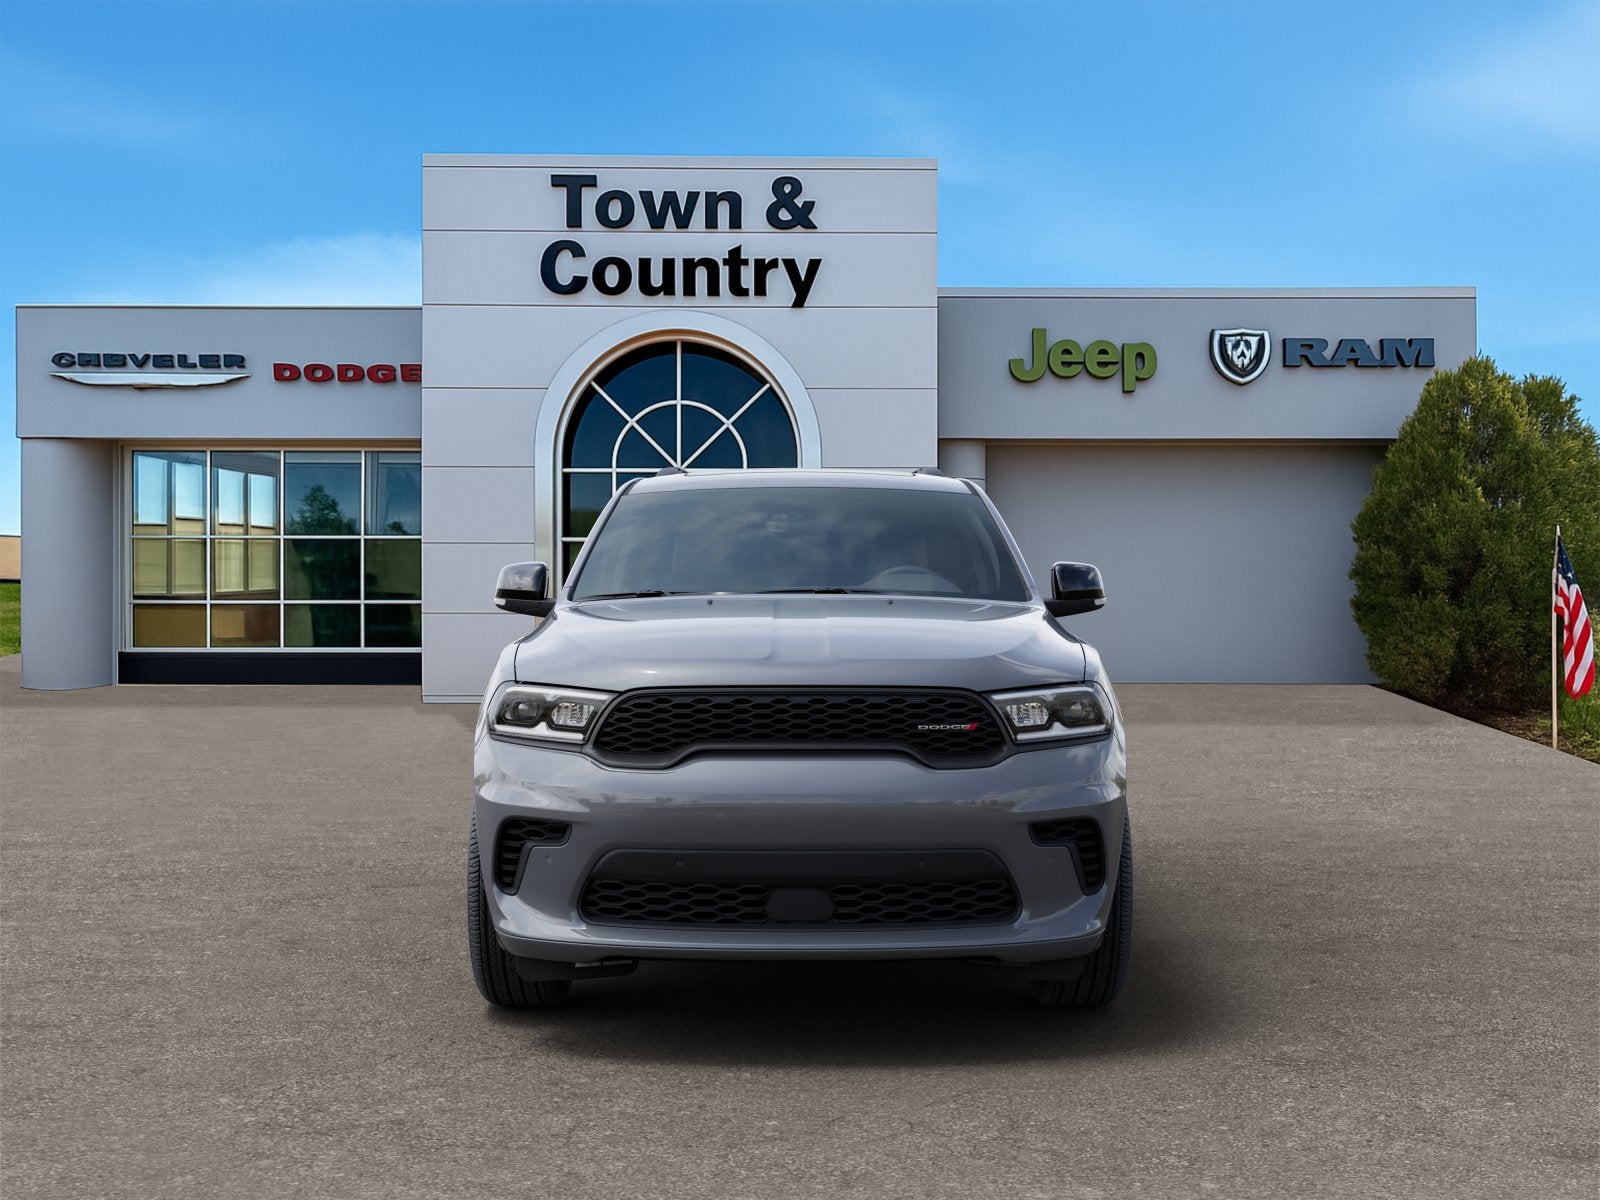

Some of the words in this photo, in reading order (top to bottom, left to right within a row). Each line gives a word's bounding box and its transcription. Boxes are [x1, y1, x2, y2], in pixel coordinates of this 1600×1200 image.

[551, 174, 742, 229] Town
[765, 176, 818, 230] &
[540, 239, 822, 308] Country
[273, 362, 422, 383] DODGE
[1008, 327, 1157, 392] Jeep
[1282, 337, 1436, 368] RAM
